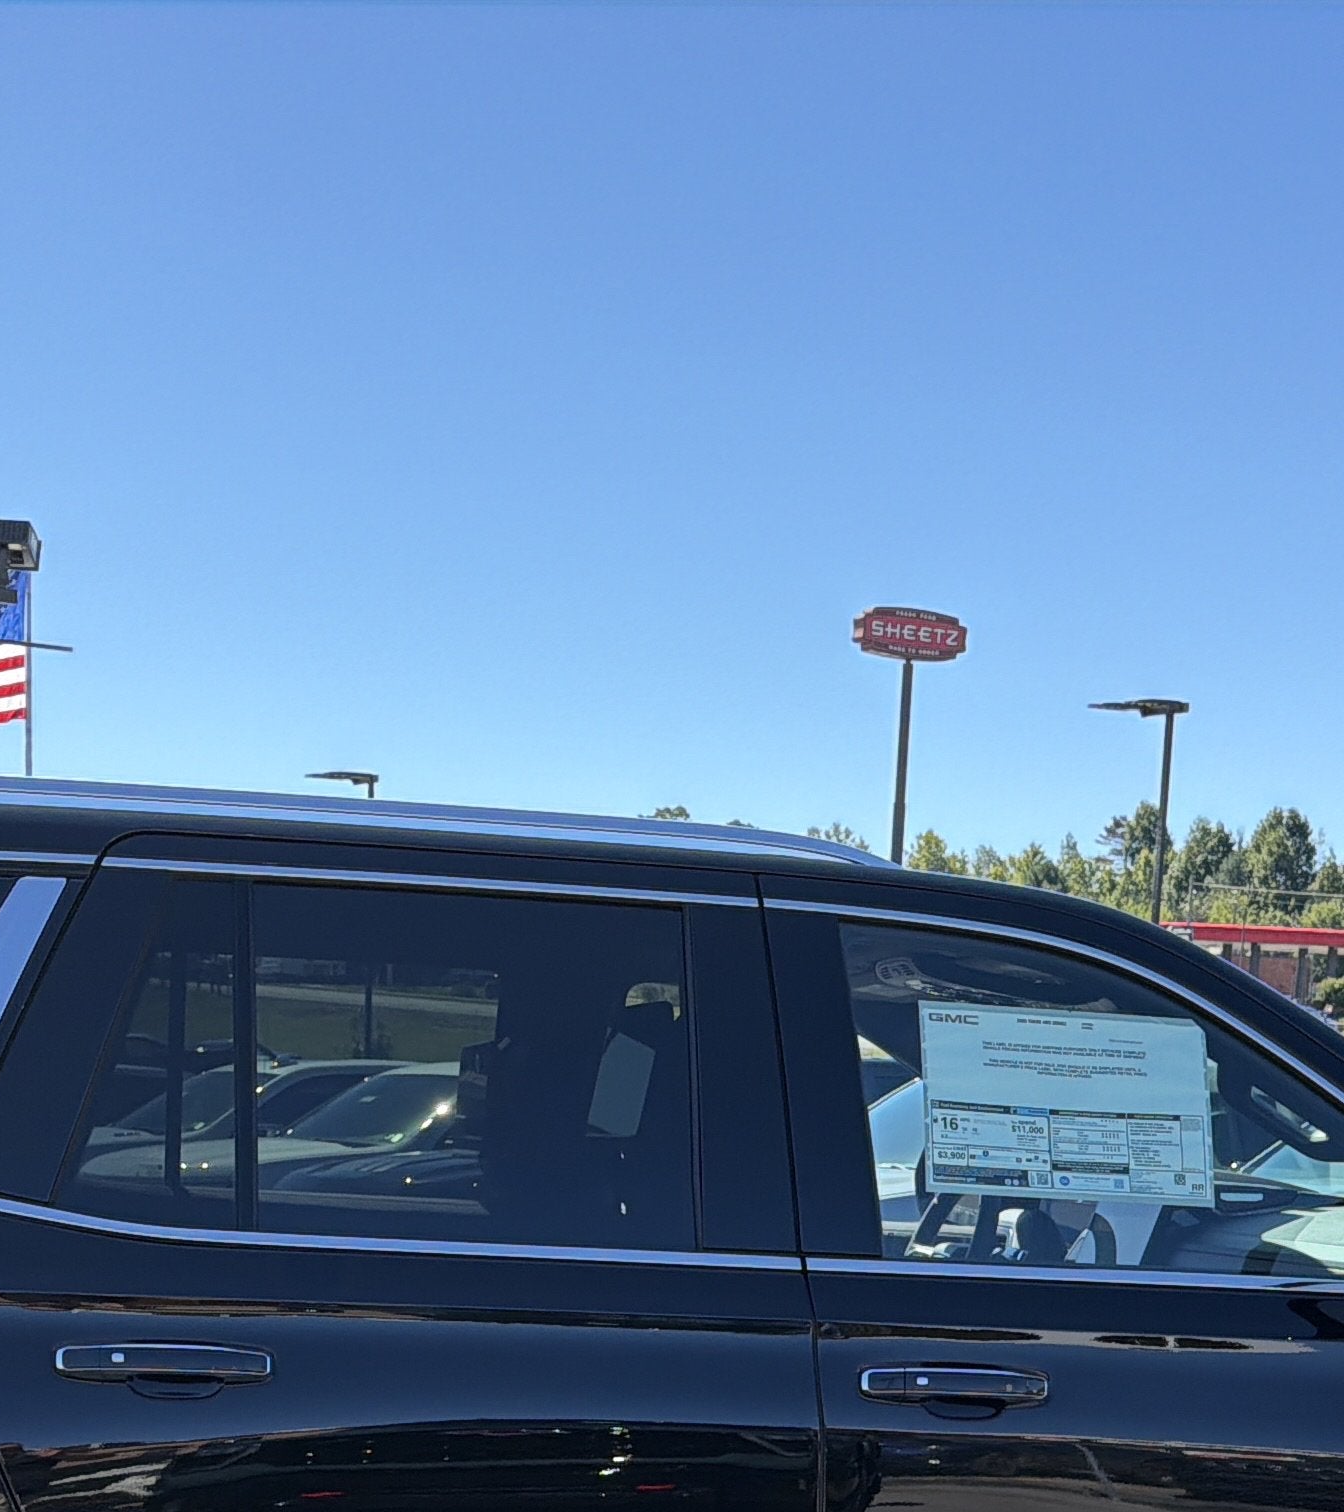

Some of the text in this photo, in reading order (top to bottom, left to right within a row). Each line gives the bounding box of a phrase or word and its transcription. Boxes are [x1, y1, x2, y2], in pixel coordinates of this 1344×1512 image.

[871, 620, 959, 646] SHEETZ
[928, 1013, 979, 1025] GMC
[941, 1117, 959, 1131] 16
[1011, 1125, 1044, 1135] $11,000
[937, 1151, 966, 1160] $3,900
